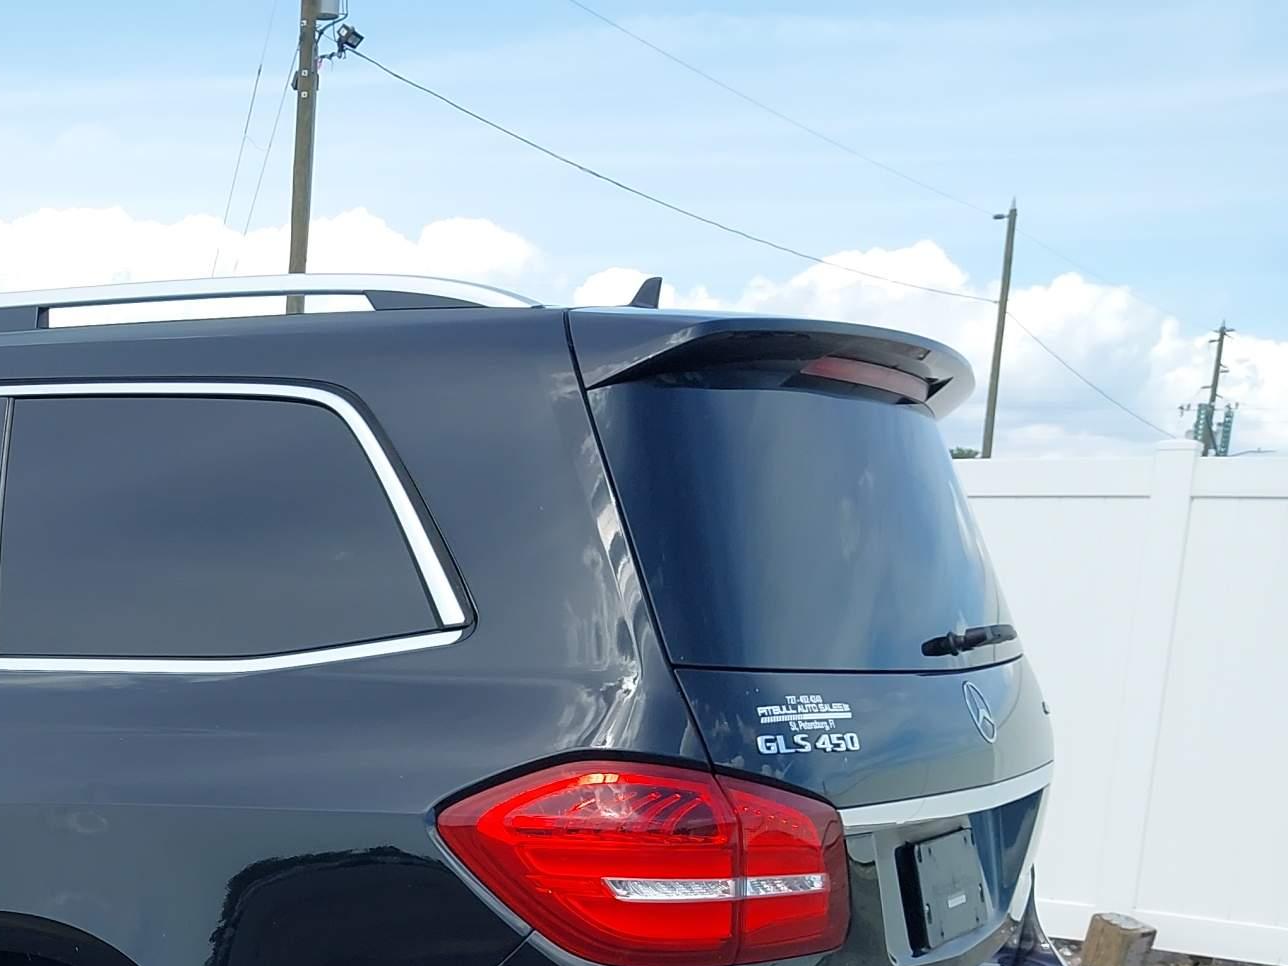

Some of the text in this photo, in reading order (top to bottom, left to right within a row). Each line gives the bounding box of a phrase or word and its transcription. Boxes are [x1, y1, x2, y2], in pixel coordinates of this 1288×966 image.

[757, 705, 797, 716] PITBULL
[798, 704, 819, 713] AUTO
[757, 733, 860, 754] GLS 450
